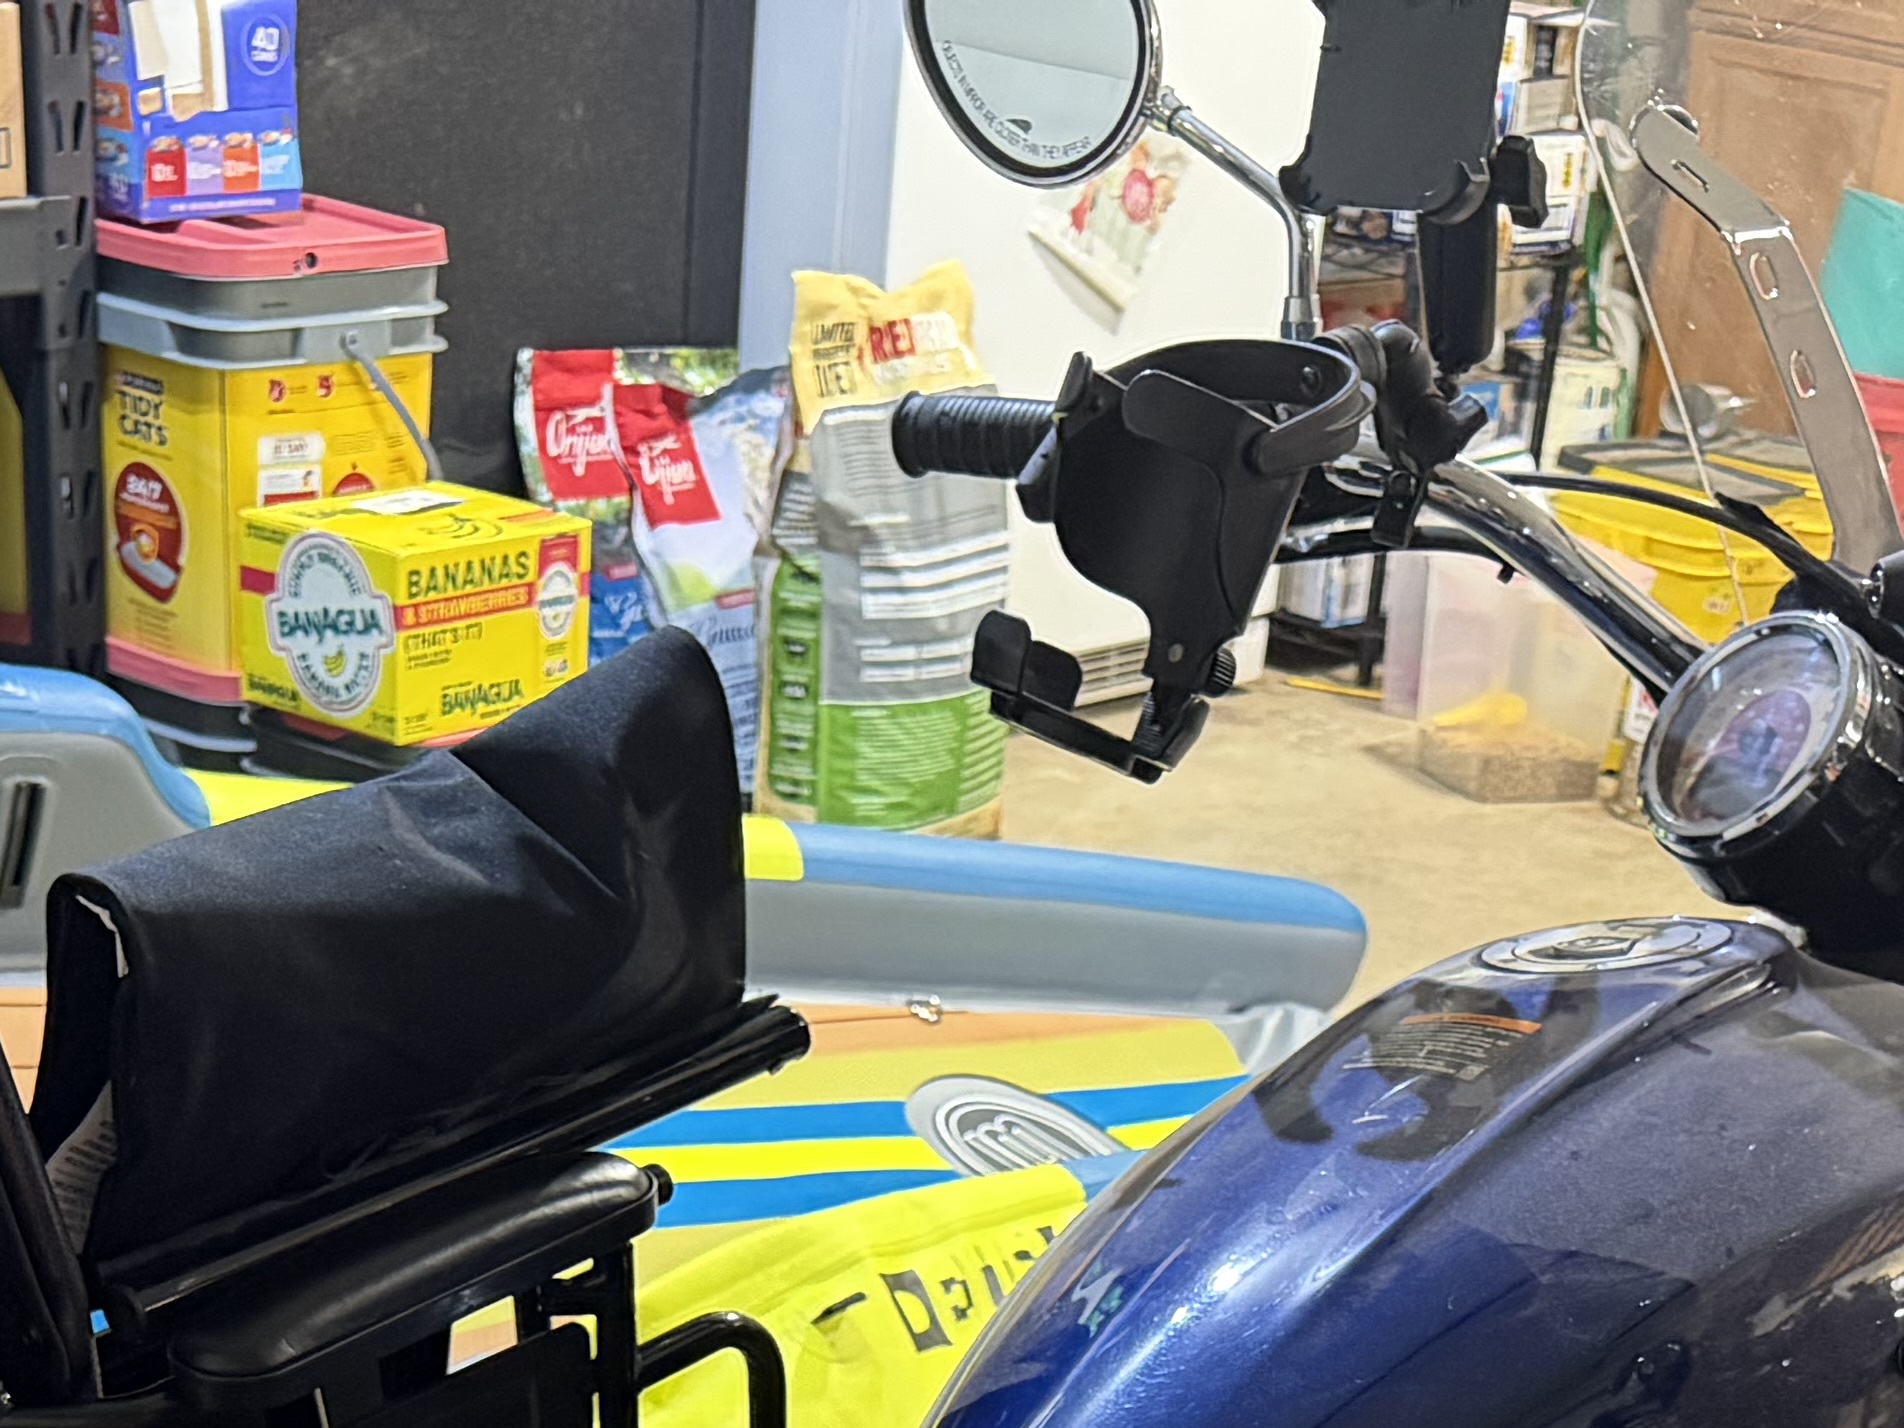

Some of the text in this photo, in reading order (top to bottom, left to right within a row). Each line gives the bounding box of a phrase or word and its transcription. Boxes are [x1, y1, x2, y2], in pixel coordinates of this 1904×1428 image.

[117, 391, 165, 418] TIDY
[118, 414, 168, 447] CATS
[407, 551, 530, 599] BANANAS
